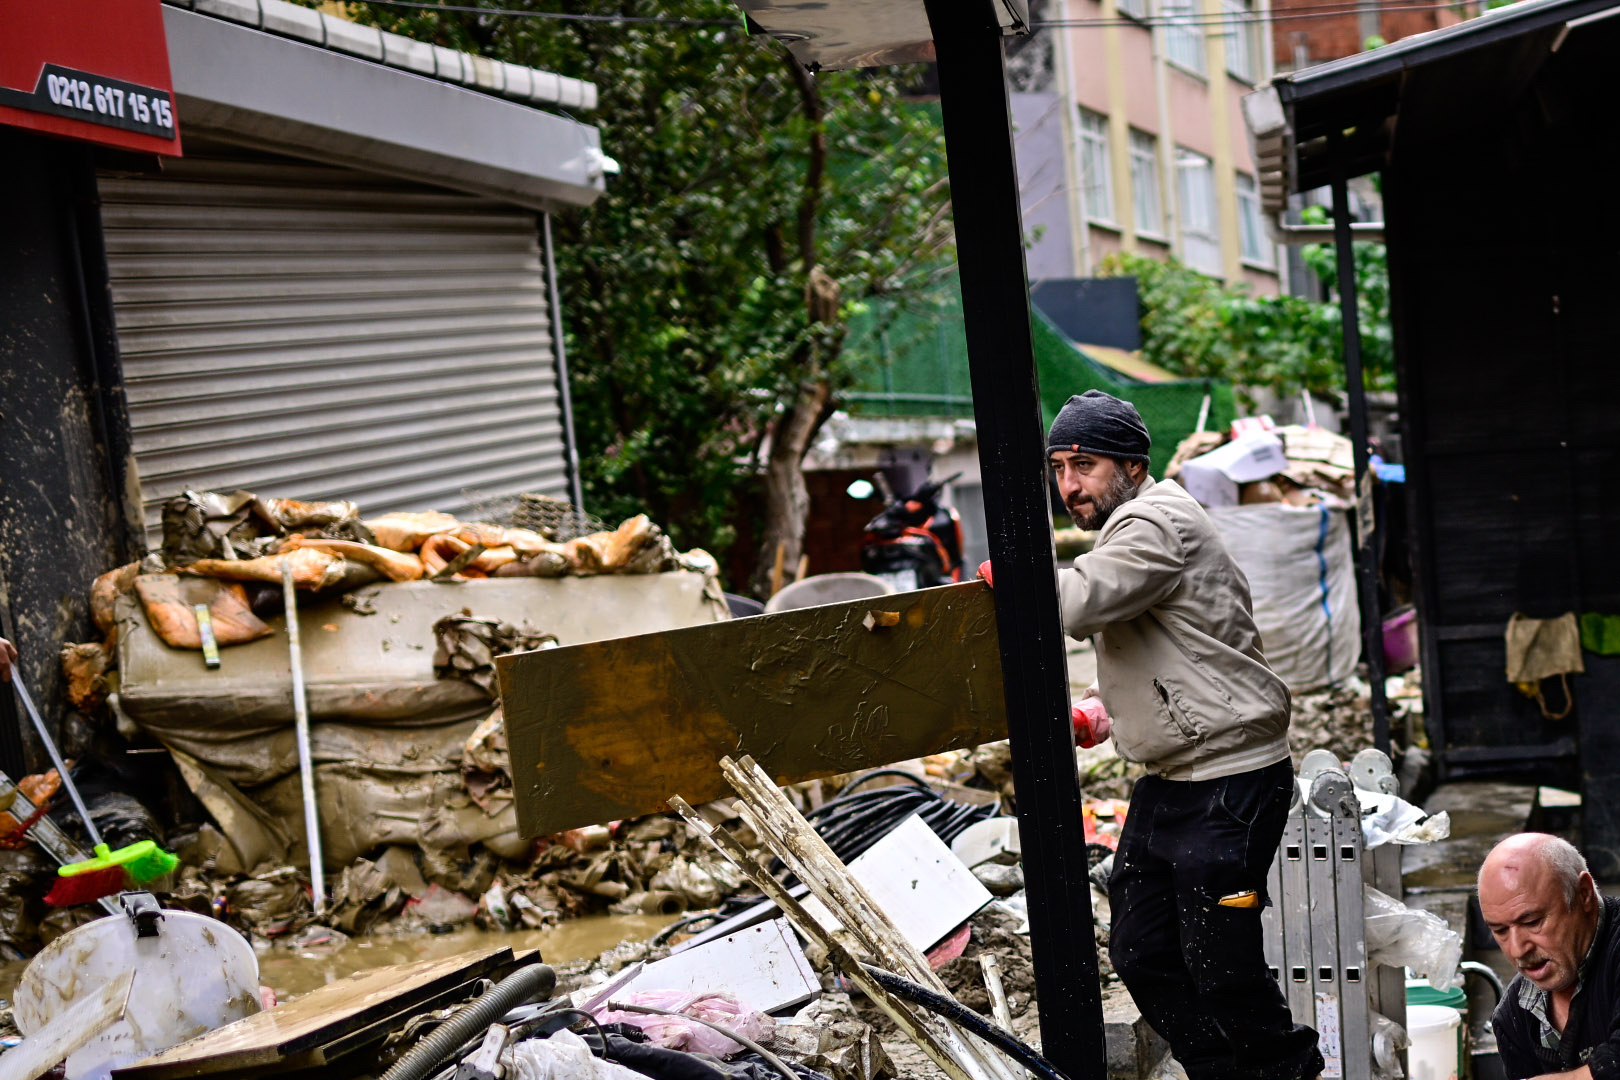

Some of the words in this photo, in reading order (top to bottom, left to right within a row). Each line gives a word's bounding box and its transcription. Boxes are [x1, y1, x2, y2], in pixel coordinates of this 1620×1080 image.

[47, 74, 94, 111] 0212
[94, 84, 124, 118] 617
[128, 92, 150, 123] 15
[151, 98, 173, 128] 15
